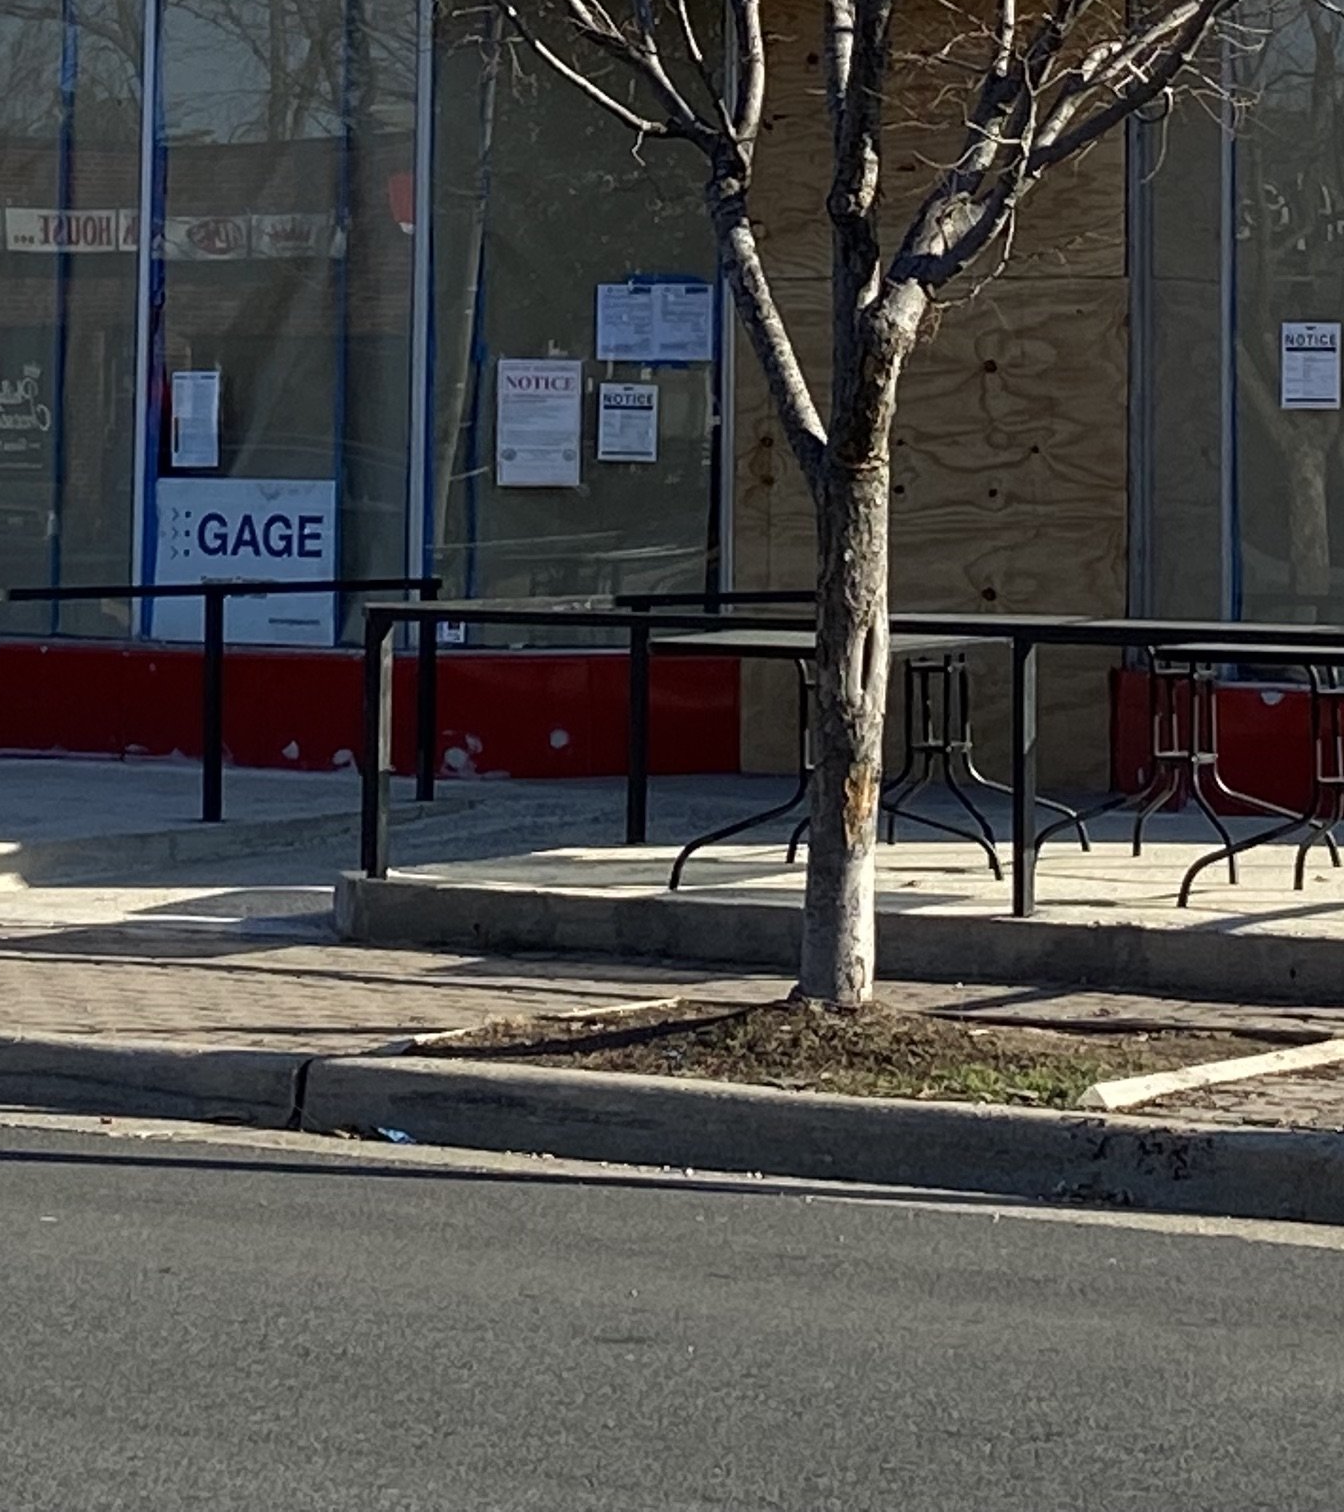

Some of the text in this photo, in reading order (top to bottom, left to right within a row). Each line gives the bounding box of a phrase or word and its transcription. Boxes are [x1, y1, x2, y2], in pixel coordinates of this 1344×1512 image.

[1285, 333, 1337, 346] NOTICE
[506, 374, 575, 392] NOTICE
[603, 393, 653, 406] NOTICE
[197, 512, 324, 558] GAGE
